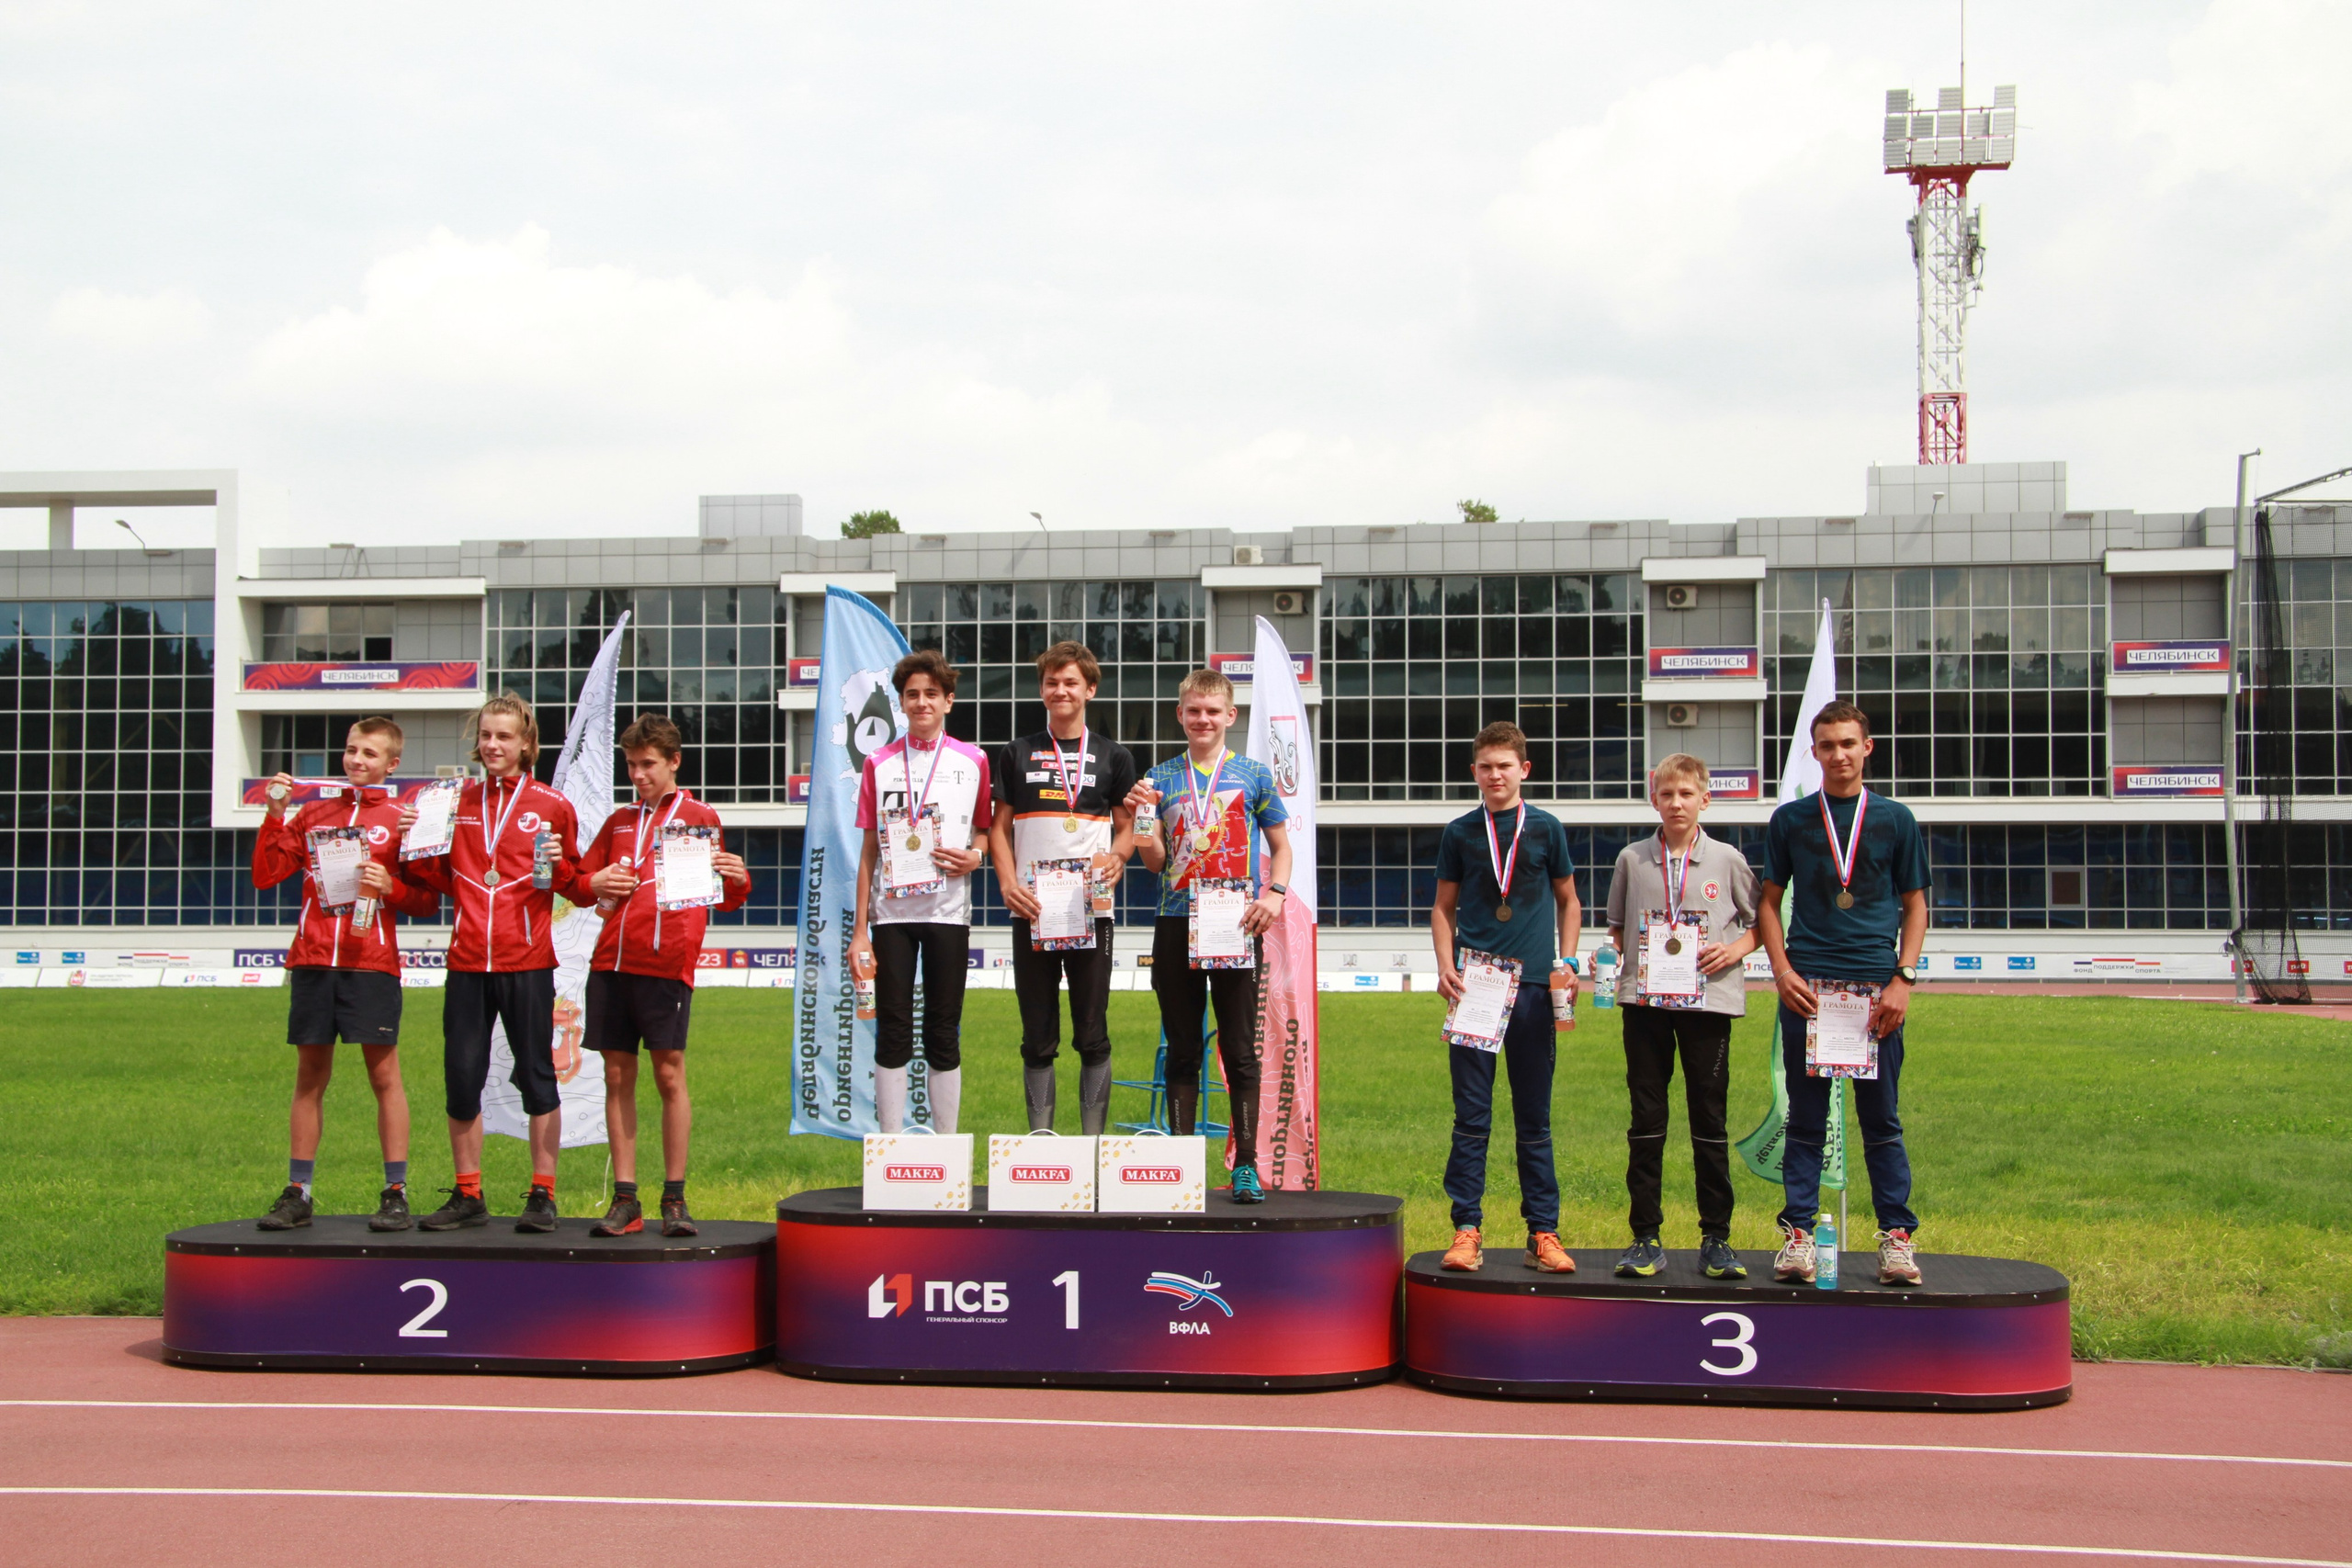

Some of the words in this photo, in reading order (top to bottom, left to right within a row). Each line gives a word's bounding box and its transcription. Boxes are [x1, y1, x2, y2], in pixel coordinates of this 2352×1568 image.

[2129, 650, 2218, 661] ЧЕЛЯБИНСК
[1664, 657, 1746, 667] ЧЕЛЯБИНСК
[323, 671, 397, 682] ЧЕЛЯБИНСК
[2129, 776, 2218, 786] ЧЕЛЯБИНСК
[322, 846, 357, 857] ГРАМОТА
[1042, 879, 1079, 887] ГРАМОТА
[239, 953, 275, 966] ПСБ
[197, 975, 218, 983] ПСБ
[410, 977, 431, 986] ПСБ
[1468, 972, 1506, 987] ГРАМОТА
[1823, 1001, 1864, 1010] ГРАМОТА
[889, 1168, 939, 1179] MAKFA
[1015, 1168, 1066, 1180] MAKFA
[1125, 1169, 1176, 1181] MAKFA
[924, 1280, 1010, 1313] ПСБ
[1052, 1270, 1080, 1329] 1
[399, 1278, 448, 1337] 2
[925, 1315, 975, 1324] ГЕНЕРАЛЬНЫЙ
[1169, 1321, 1211, 1336] ВФЛА
[1699, 1312, 1758, 1376] 3
